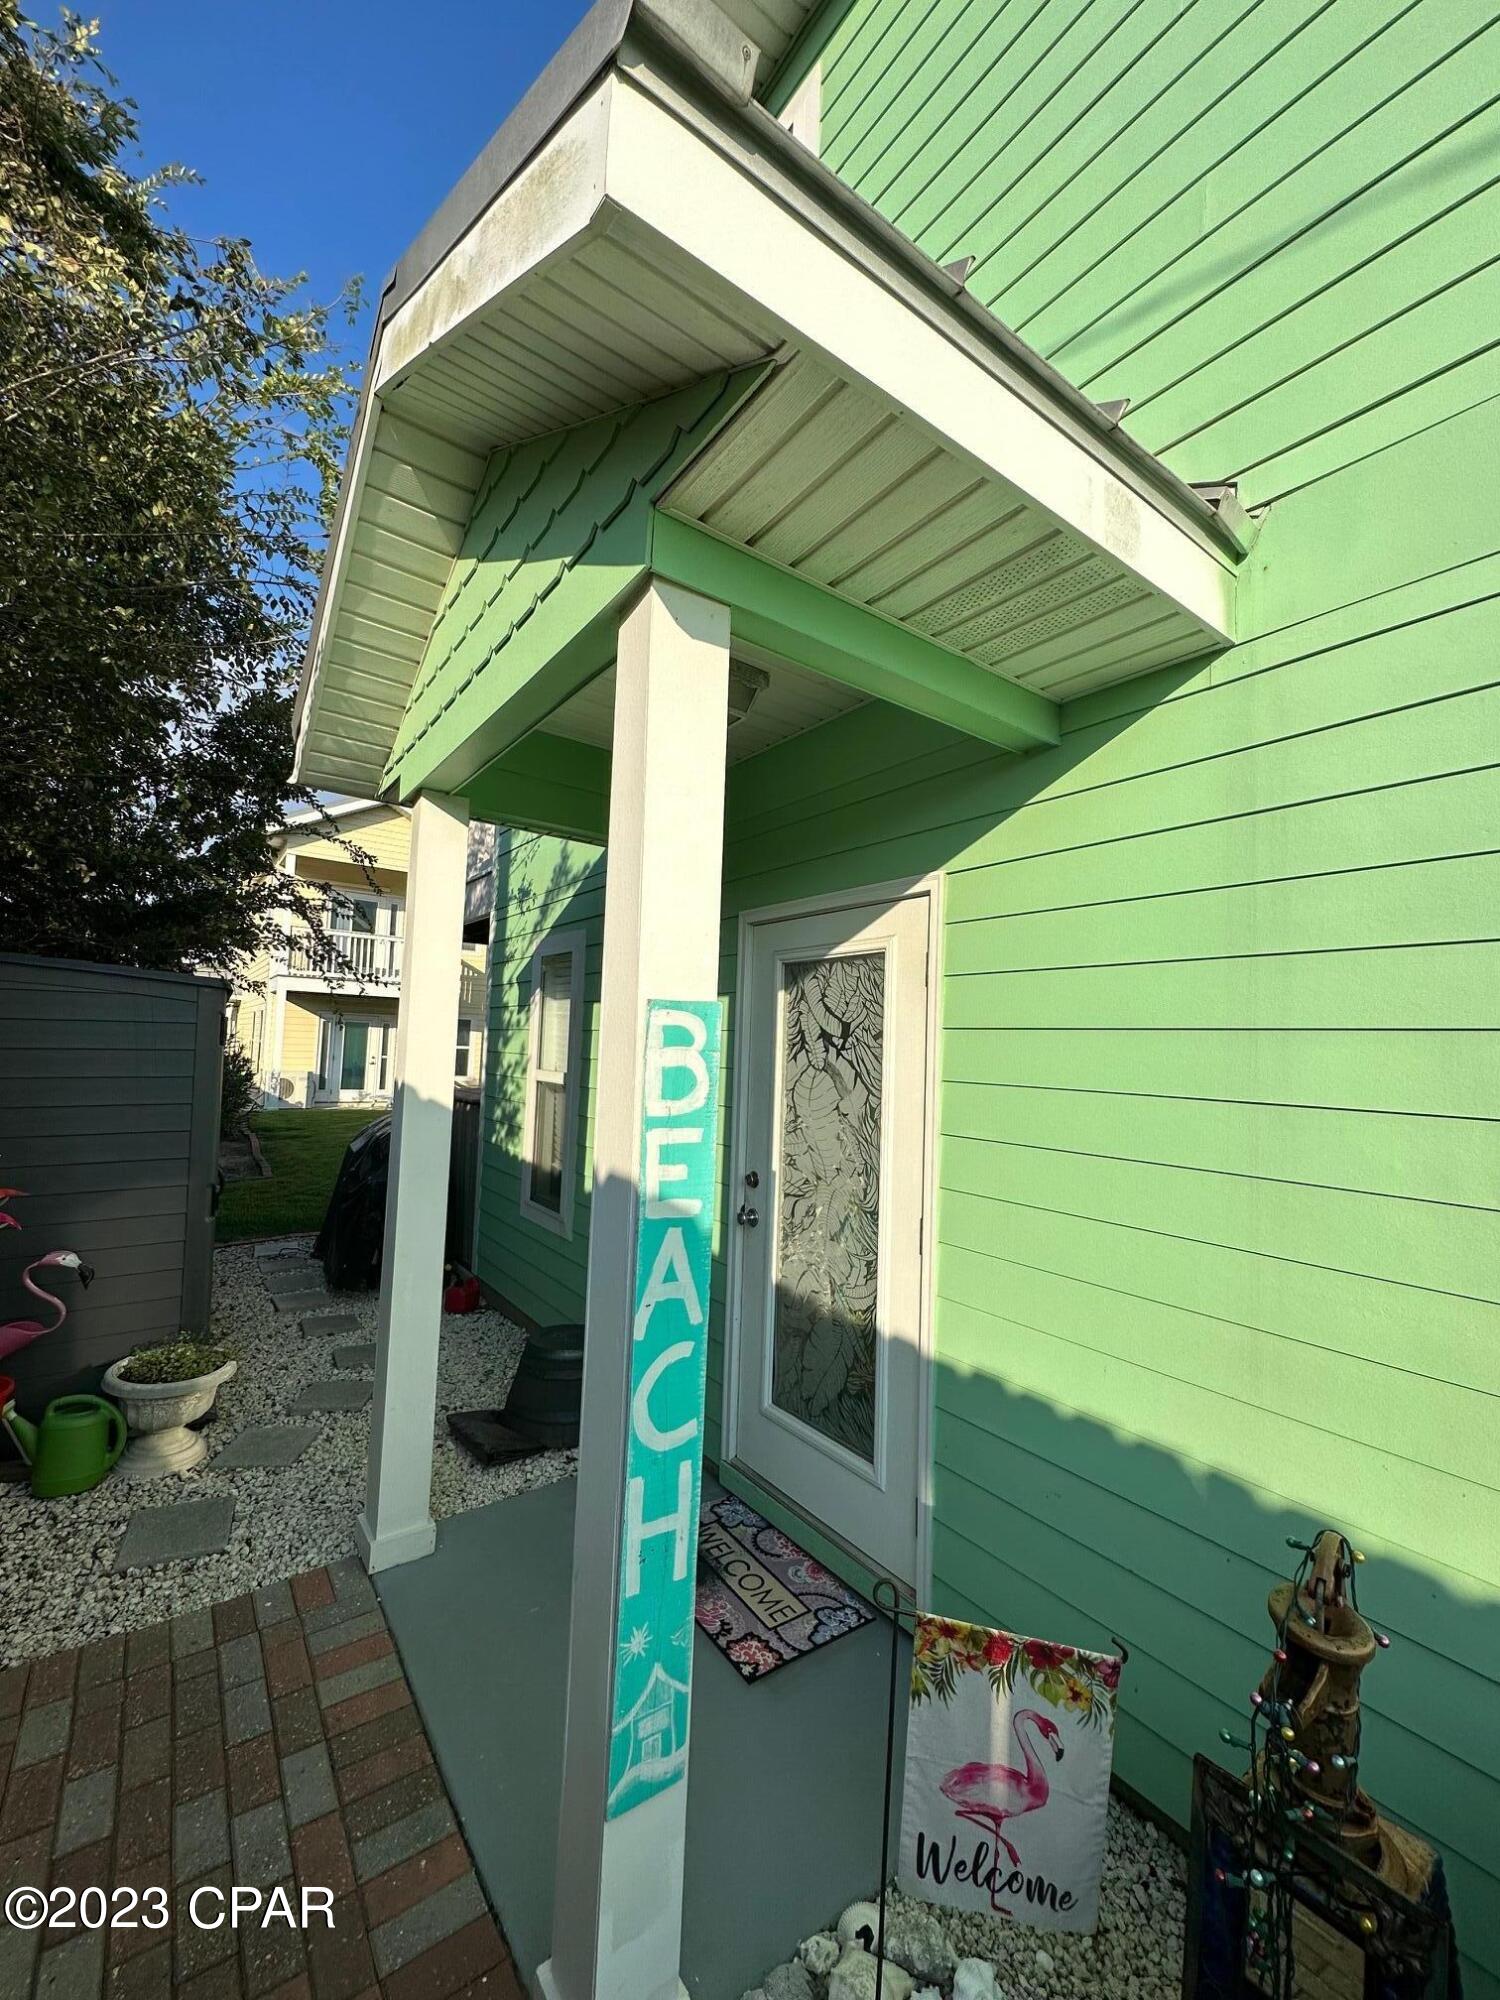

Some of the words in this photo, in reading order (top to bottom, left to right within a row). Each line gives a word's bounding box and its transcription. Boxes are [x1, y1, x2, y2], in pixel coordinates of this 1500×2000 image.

[626, 1008, 710, 1599] BEACH
[699, 1526, 798, 1623] WELCOME
[916, 1831, 1079, 1912] Welcome
